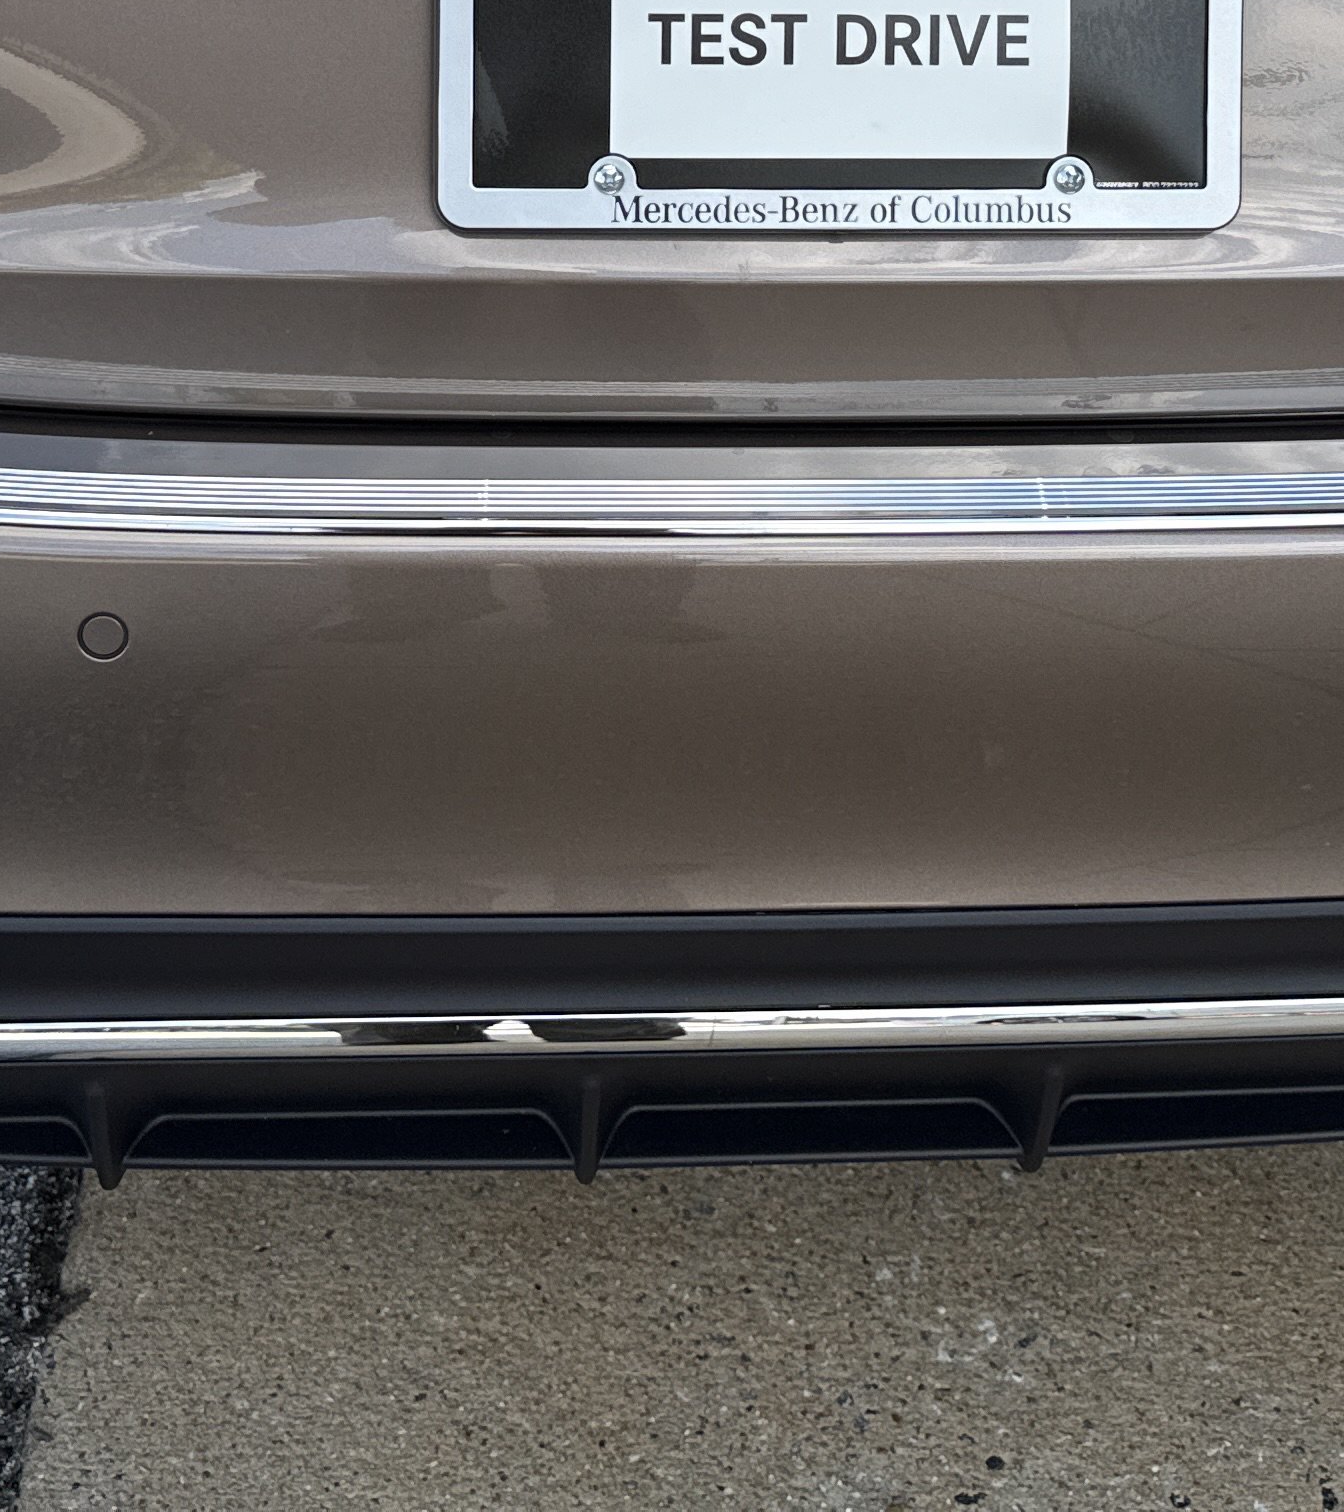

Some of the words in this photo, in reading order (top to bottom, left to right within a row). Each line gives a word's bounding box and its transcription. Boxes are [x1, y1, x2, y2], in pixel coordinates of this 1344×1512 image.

[647, 13, 808, 67] TEST
[834, 14, 1031, 67] DRIVE
[611, 195, 859, 224] Mercedes-Benz
[870, 195, 902, 224] of
[910, 195, 1072, 224] Columbus
